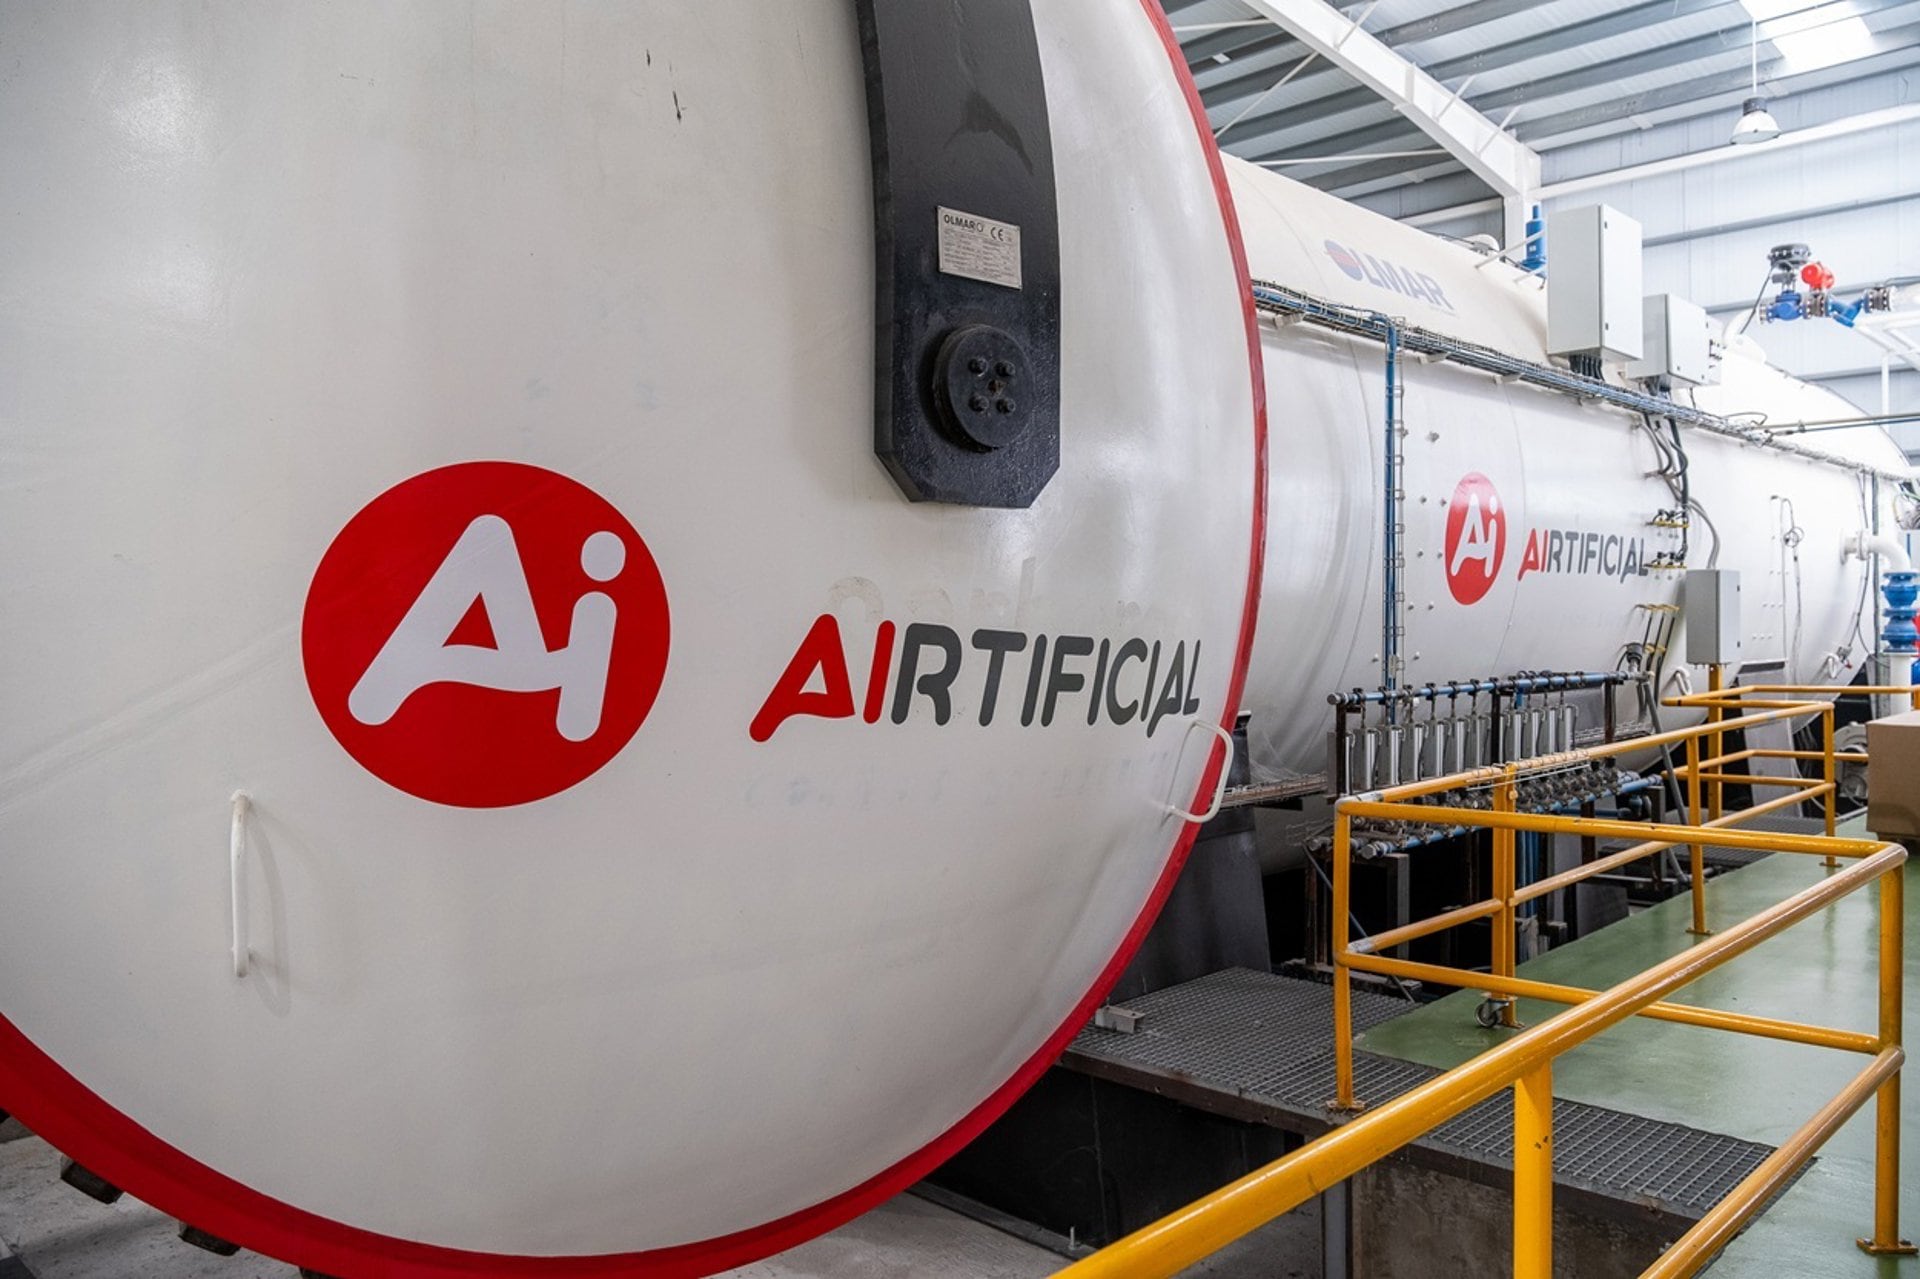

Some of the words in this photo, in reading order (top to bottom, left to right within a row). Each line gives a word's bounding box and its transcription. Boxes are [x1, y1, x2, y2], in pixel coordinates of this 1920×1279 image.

[944, 214, 976, 230] OLMAR
[1517, 528, 1649, 584] AIRTIFICIAL
[749, 613, 1201, 743] AIRTIFICIAL
